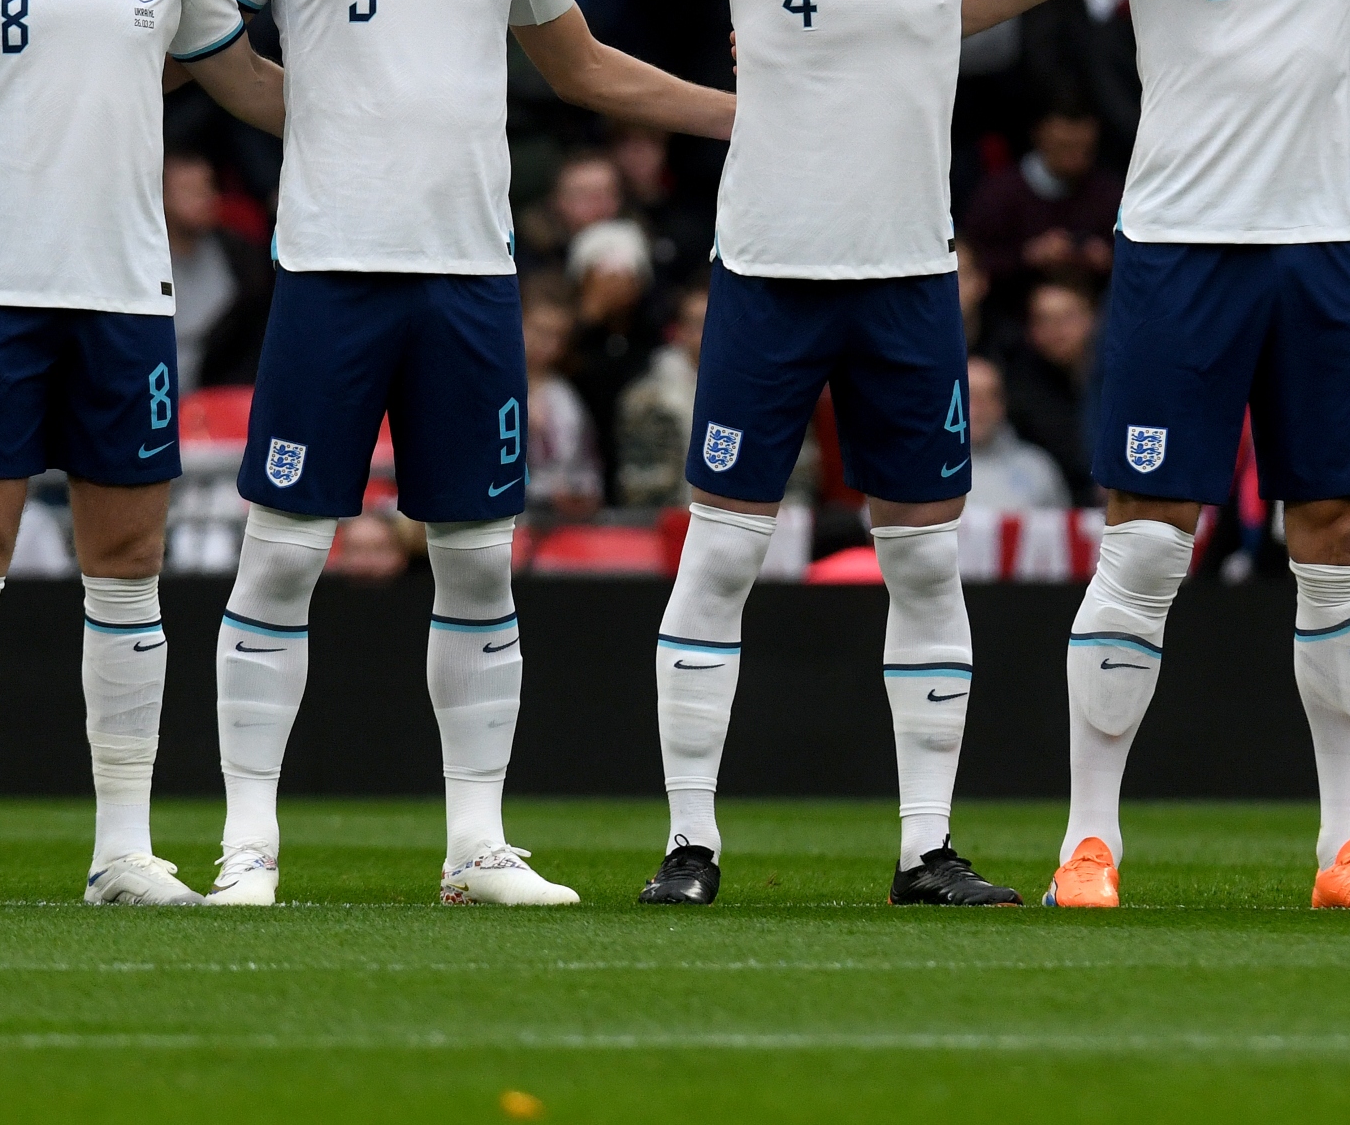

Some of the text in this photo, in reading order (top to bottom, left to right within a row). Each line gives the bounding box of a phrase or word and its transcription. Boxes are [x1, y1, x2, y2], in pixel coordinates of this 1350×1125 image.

[134, 7, 155, 19] UKRAINE
[148, 362, 172, 430] 8
[944, 379, 968, 444] 4
[498, 397, 521, 465] 9
